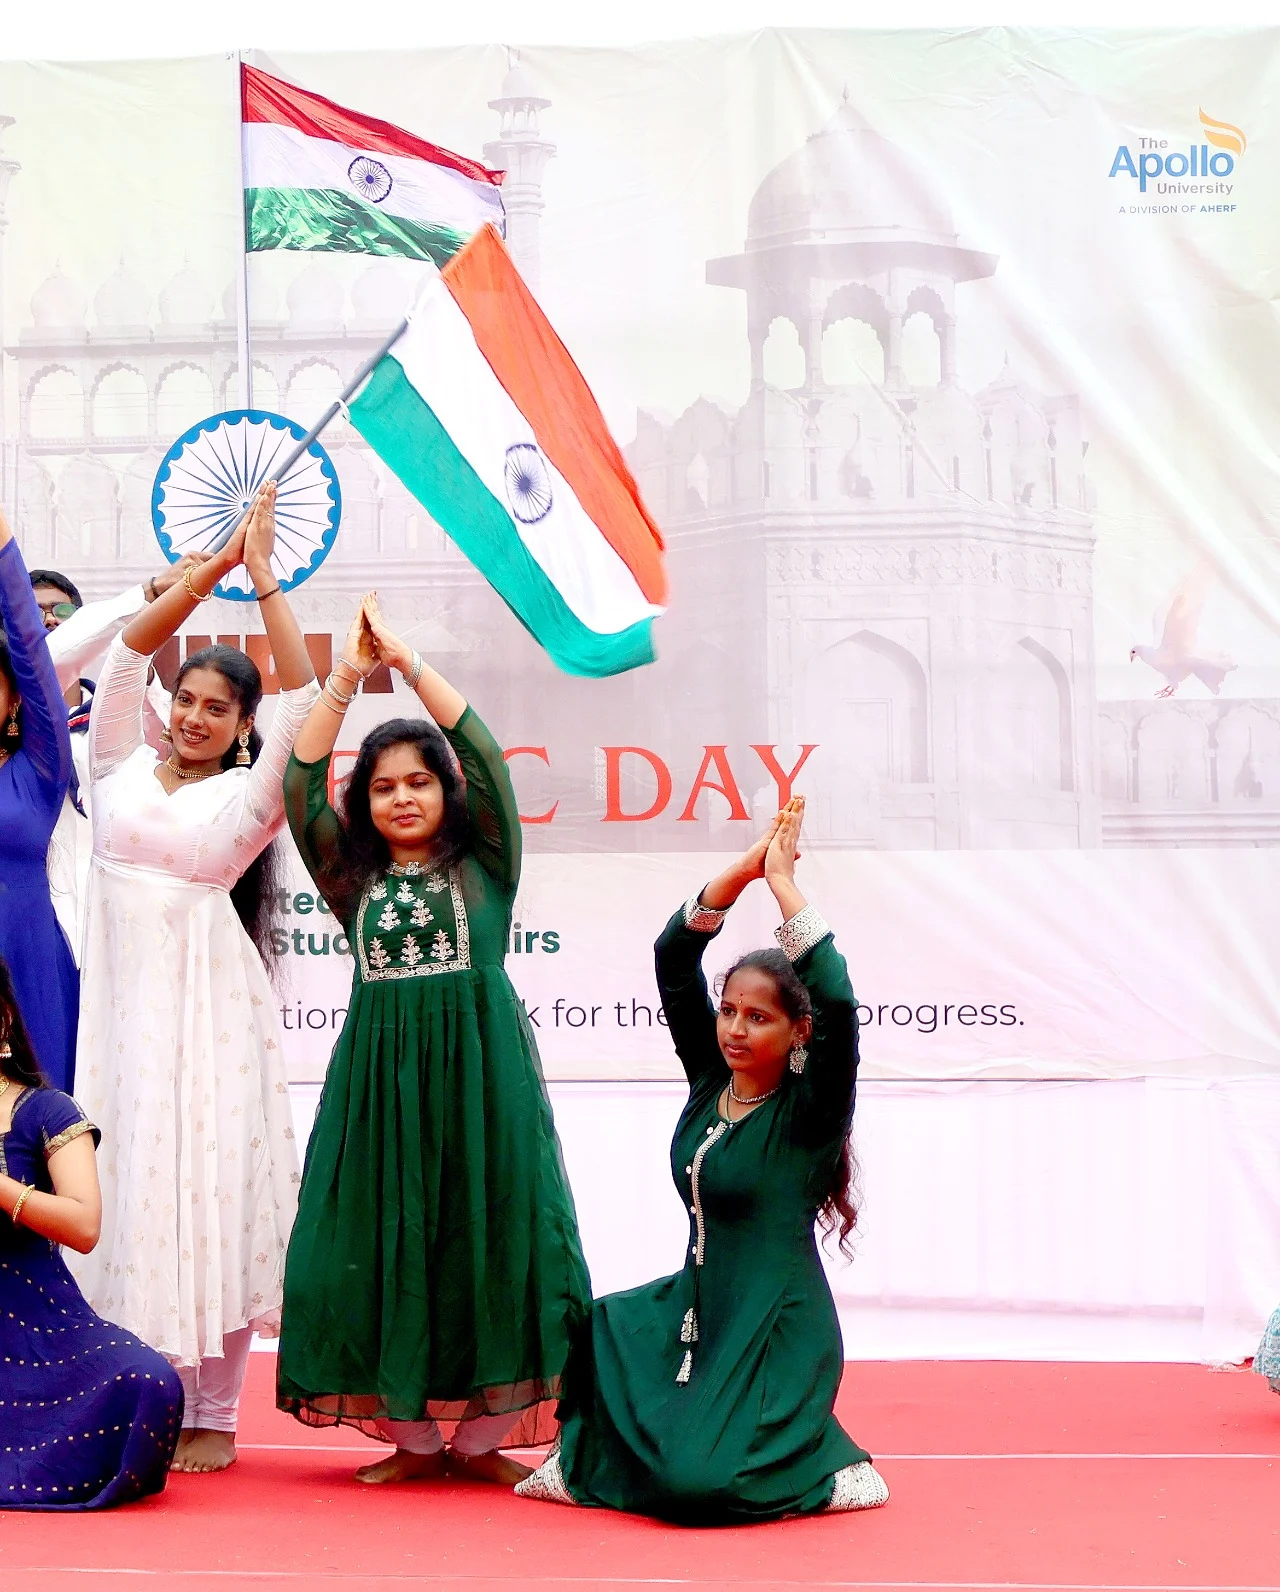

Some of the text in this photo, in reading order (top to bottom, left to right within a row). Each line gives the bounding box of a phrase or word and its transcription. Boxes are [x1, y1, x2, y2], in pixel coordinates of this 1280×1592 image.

[1138, 137, 1168, 149] The
[1108, 145, 1234, 193] Apollo
[1157, 182, 1234, 195] University
[1118, 204, 1237, 214] A DIVISION OF AHERF
[599, 744, 820, 823] DAY
[551, 998, 602, 1028] for
[613, 997, 671, 1028] the
